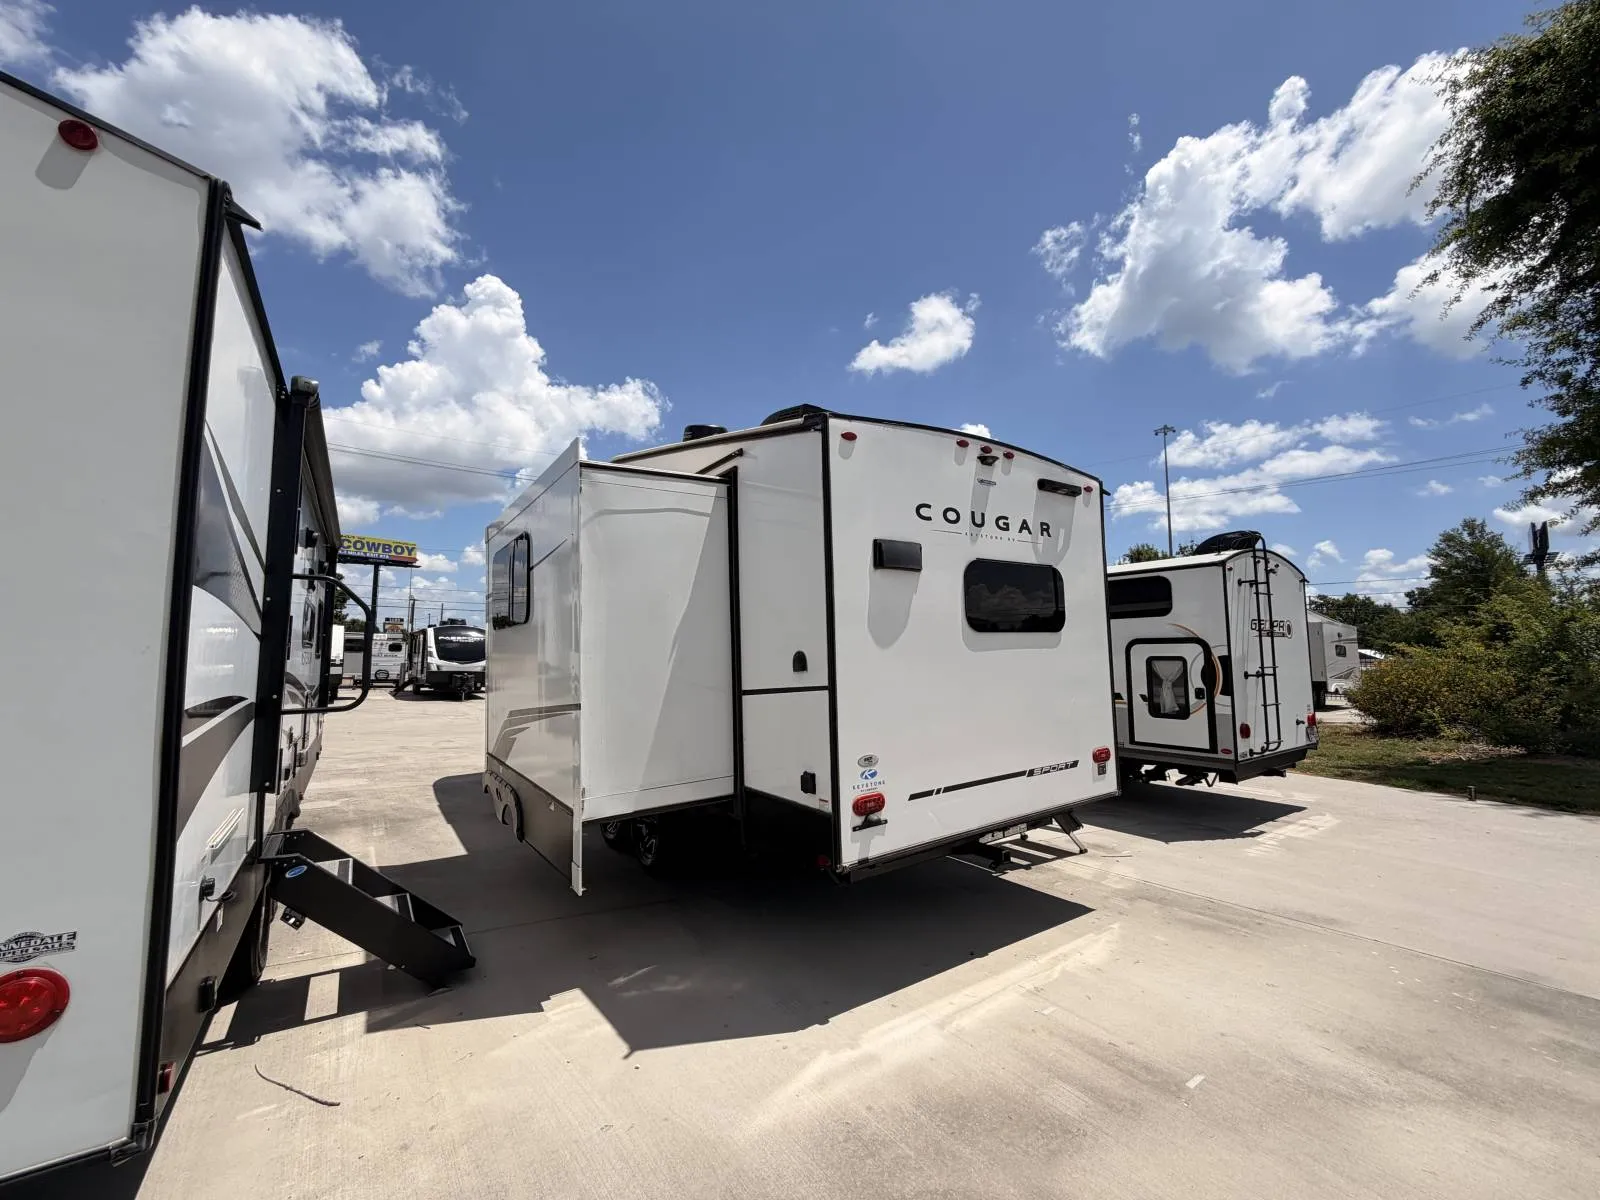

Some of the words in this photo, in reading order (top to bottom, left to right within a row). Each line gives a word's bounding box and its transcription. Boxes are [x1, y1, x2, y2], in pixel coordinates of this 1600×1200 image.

[915, 502, 1052, 537] COUGAR
[338, 538, 416, 556] COWBOY
[1032, 761, 1074, 777] SPORT
[852, 780, 885, 790] KEYSTONE
